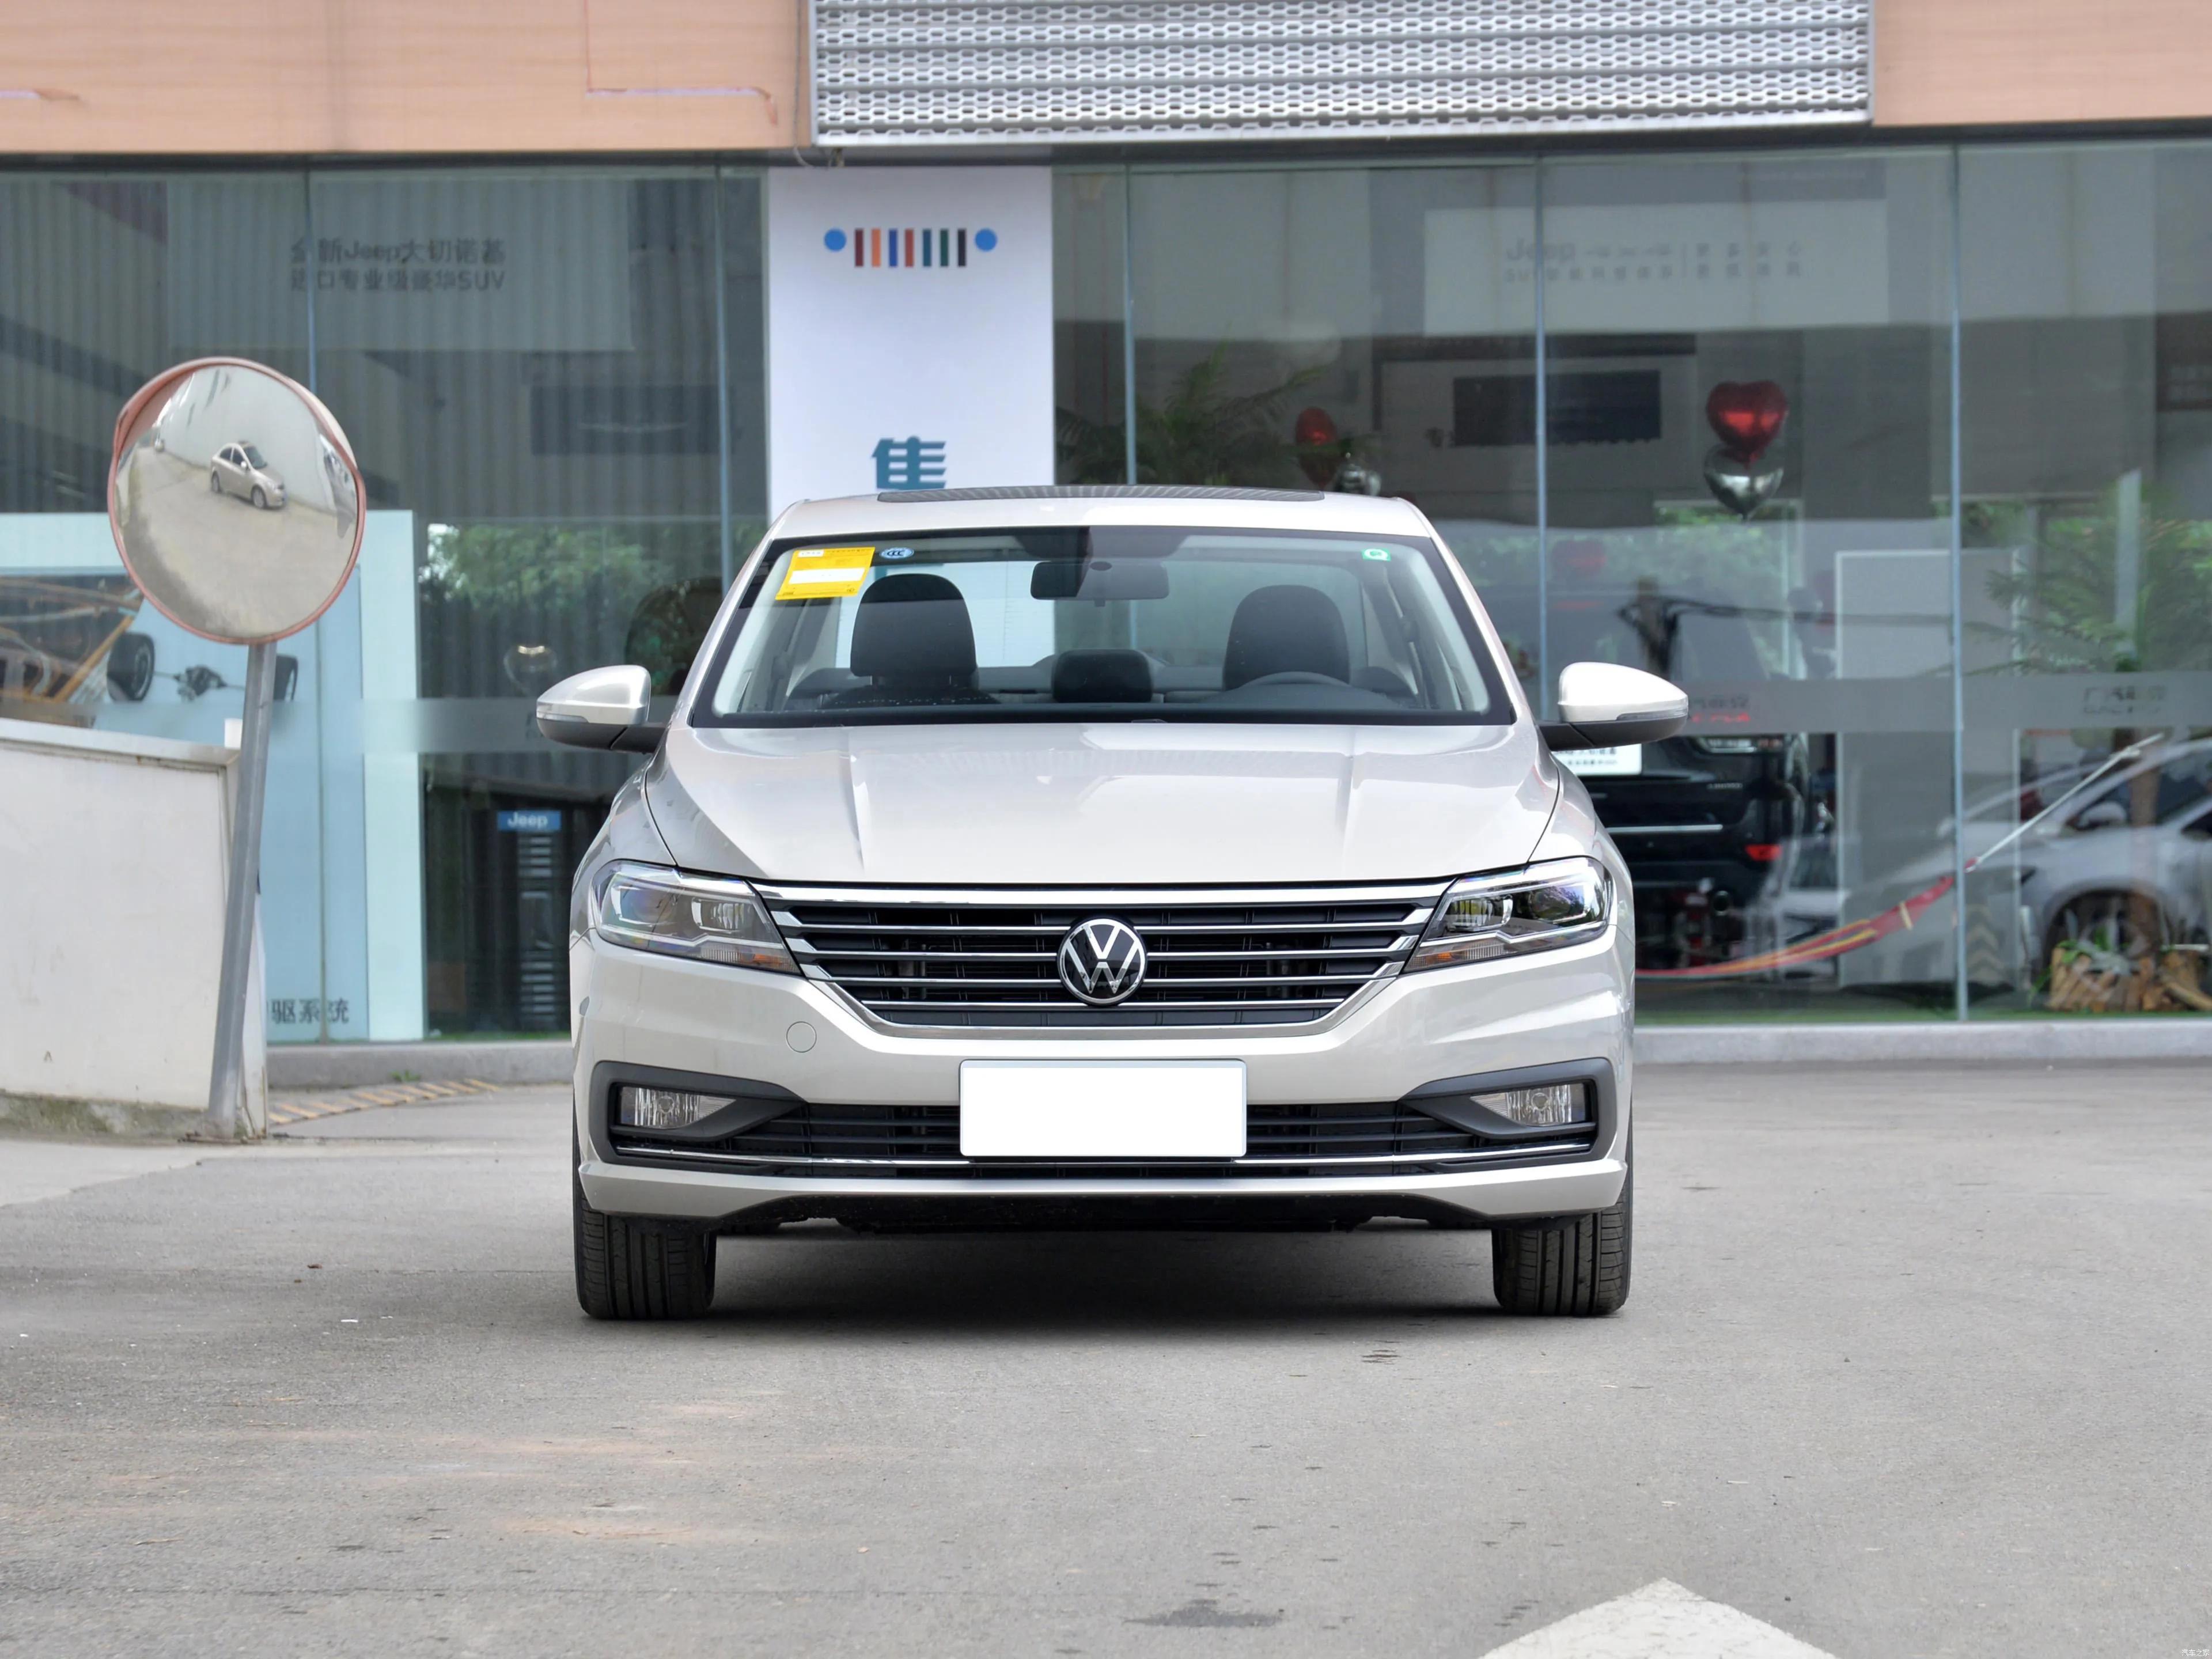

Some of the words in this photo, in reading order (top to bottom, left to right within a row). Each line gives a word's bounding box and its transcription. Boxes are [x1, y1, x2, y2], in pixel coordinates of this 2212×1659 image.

[507, 811, 548, 830] Jeep
[267, 998, 349, 1024] 驱系统
